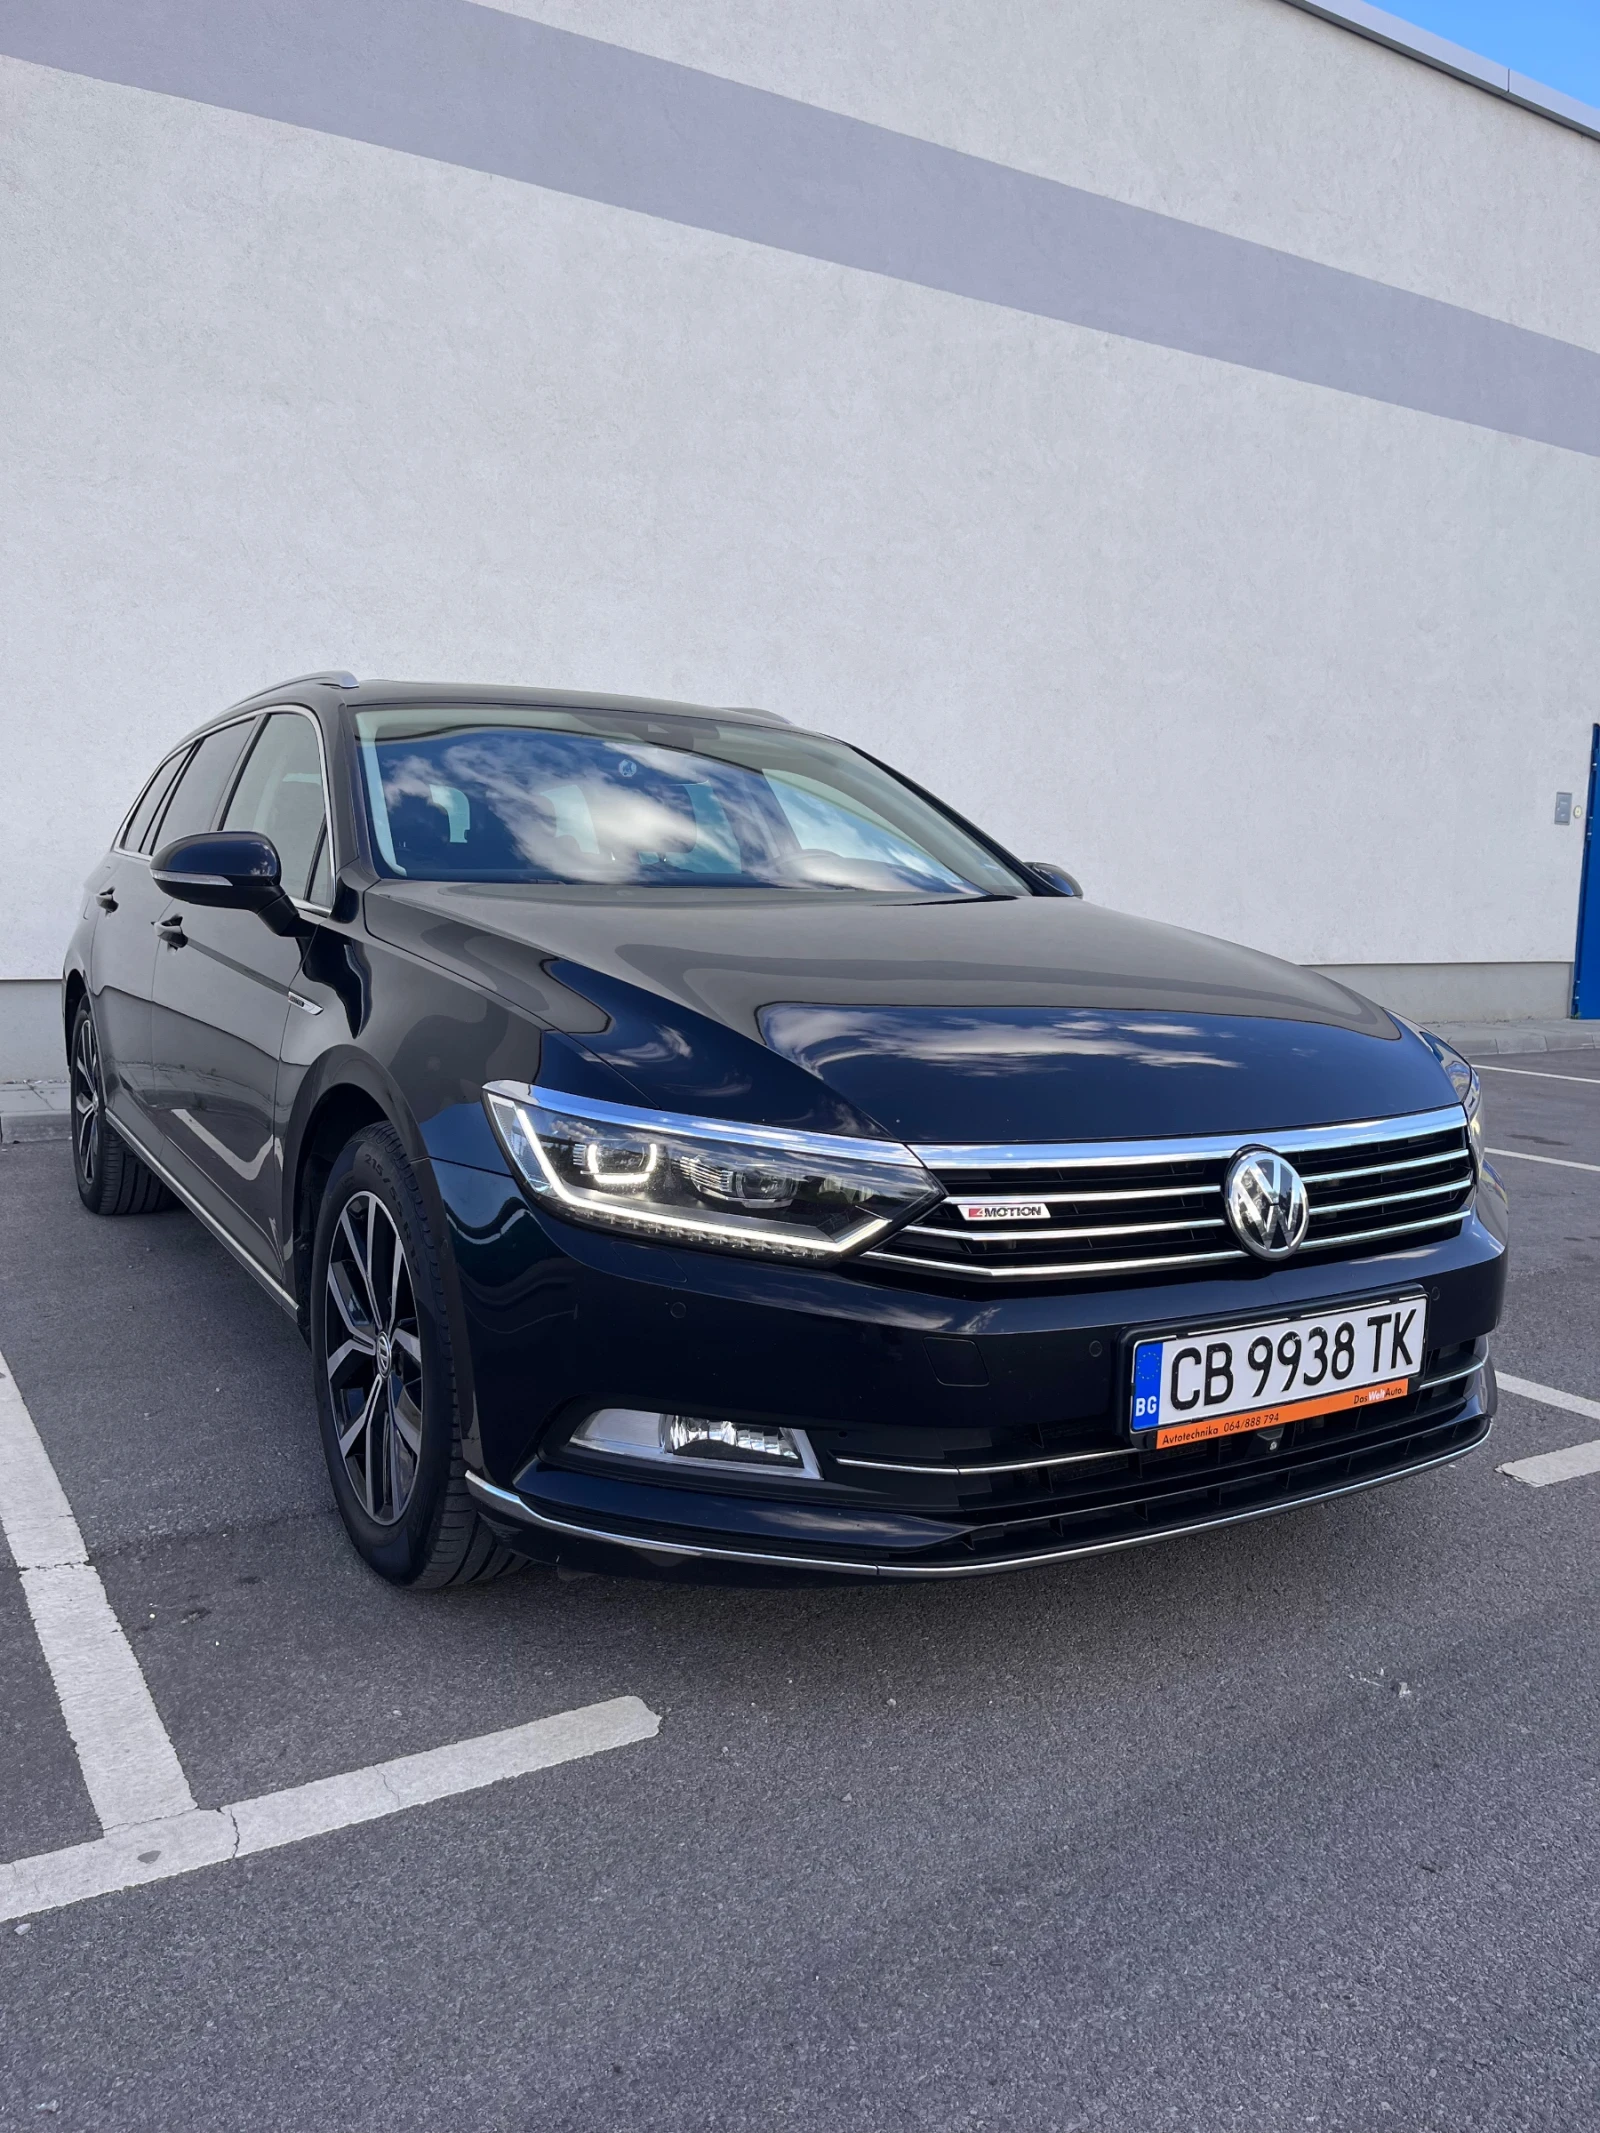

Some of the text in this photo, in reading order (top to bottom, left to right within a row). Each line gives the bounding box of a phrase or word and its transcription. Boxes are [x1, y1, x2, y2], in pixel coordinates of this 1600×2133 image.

[968, 1206, 1042, 1218] 4MOTION
[1170, 1308, 1417, 1411] CB 9938 TK
[1135, 1396, 1158, 1417] BG
[1162, 1412, 1279, 1445] Avtotechnika 064/888 794
